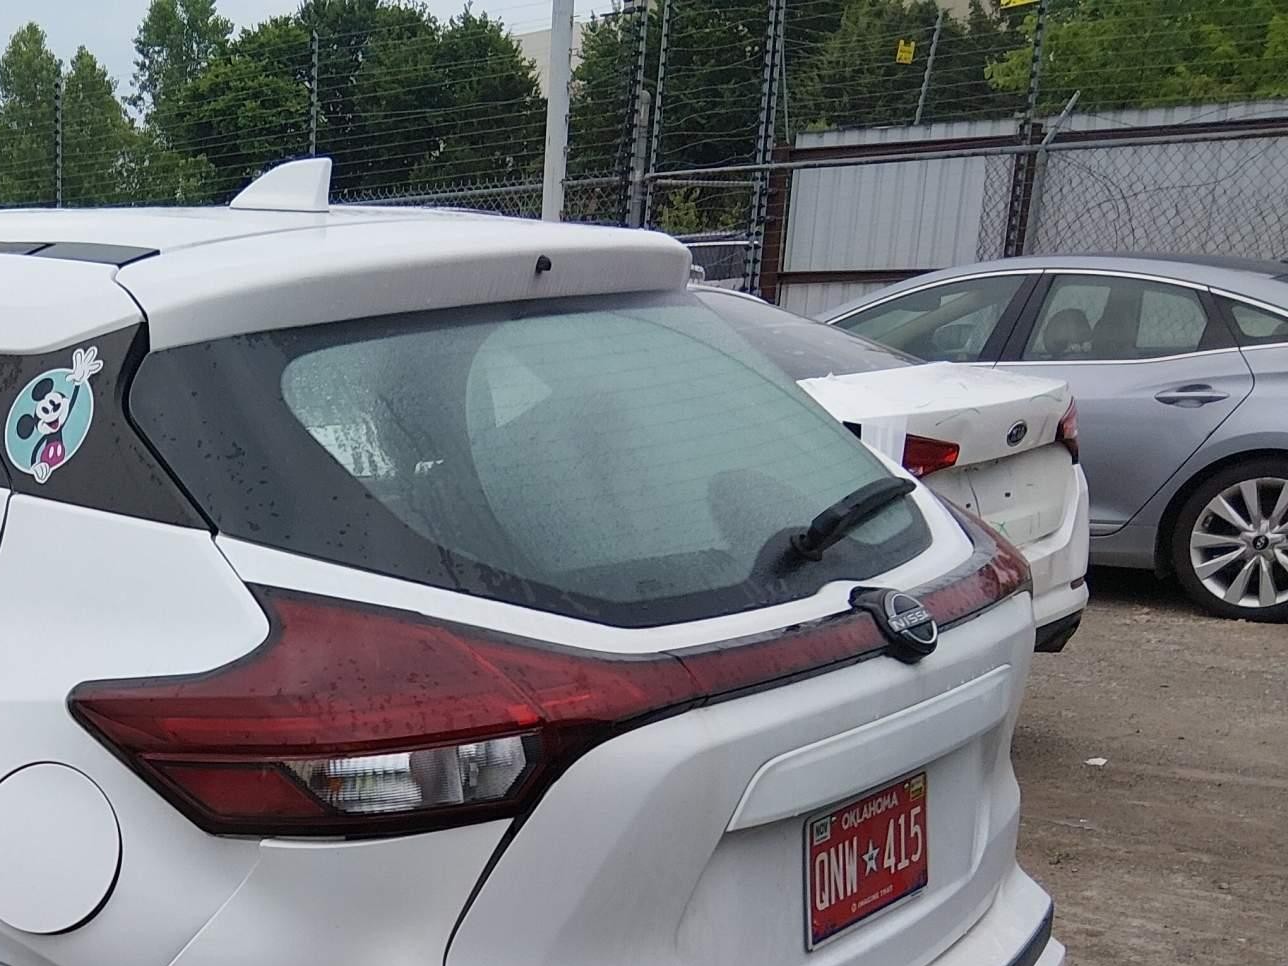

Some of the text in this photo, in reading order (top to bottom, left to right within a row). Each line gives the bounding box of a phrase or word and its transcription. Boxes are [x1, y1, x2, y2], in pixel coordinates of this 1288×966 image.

[892, 610, 929, 631] NISSA
[841, 791, 898, 830] OKLAHOMA
[815, 818, 830, 838] NOV
[815, 805, 922, 911] QNW 415
